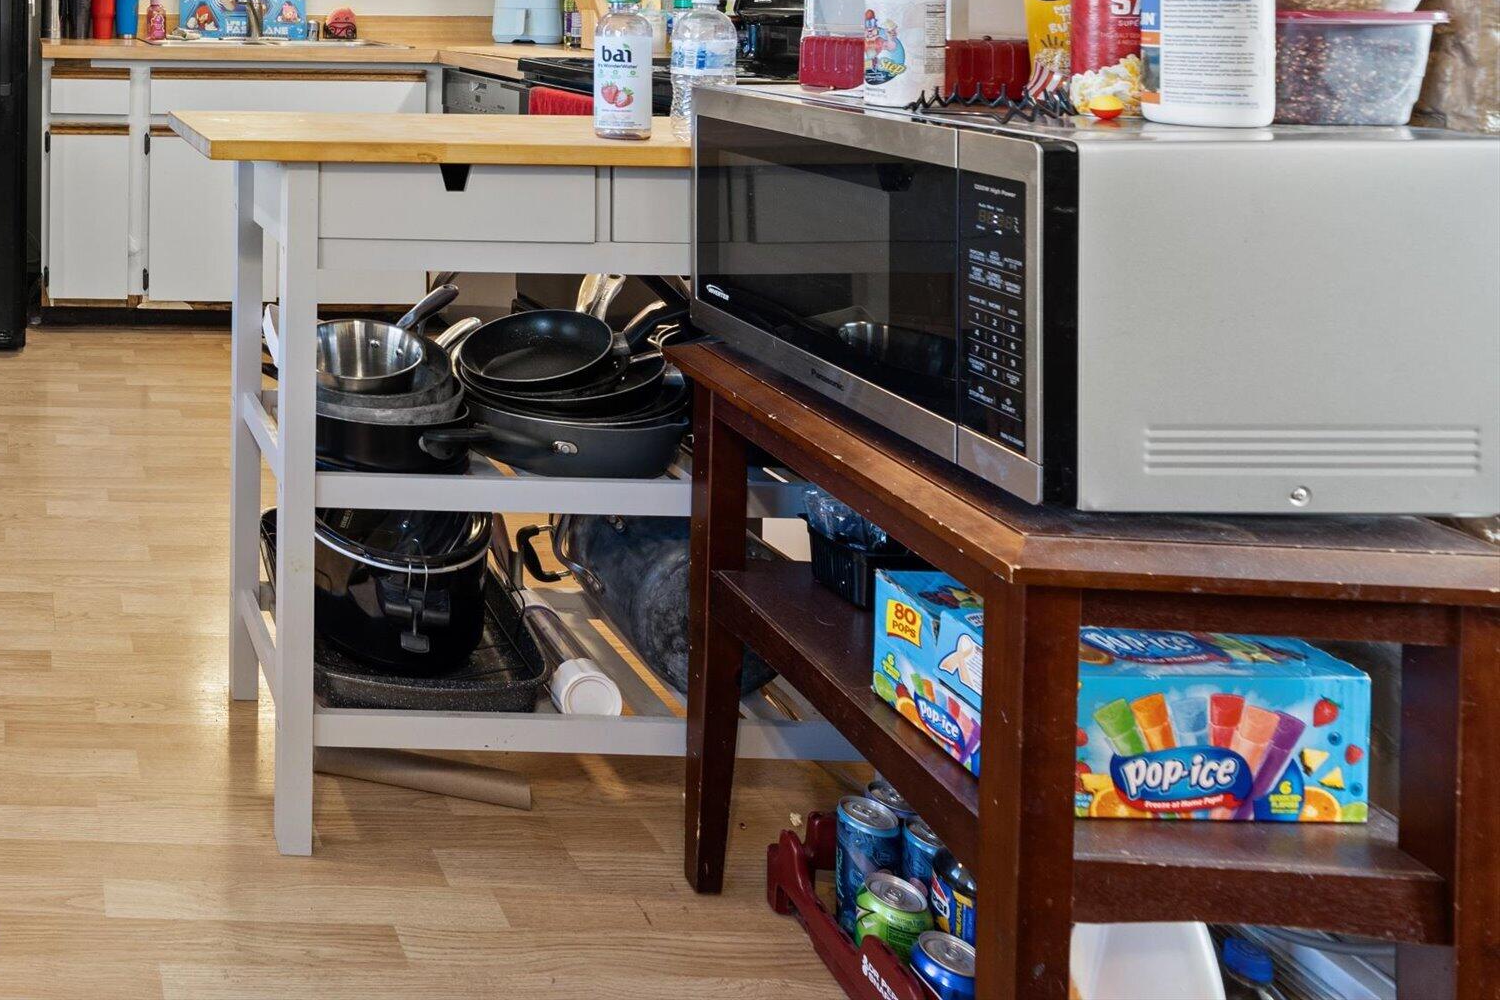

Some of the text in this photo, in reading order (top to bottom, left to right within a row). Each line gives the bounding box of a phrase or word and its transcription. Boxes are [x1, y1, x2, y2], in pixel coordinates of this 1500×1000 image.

[226, 25, 247, 34] FAS
[602, 44, 632, 63] bai
[894, 603, 916, 626] 80
[892, 619, 916, 639] POPS
[918, 699, 960, 738] pop-ice
[1124, 754, 1236, 797] pop-ice
